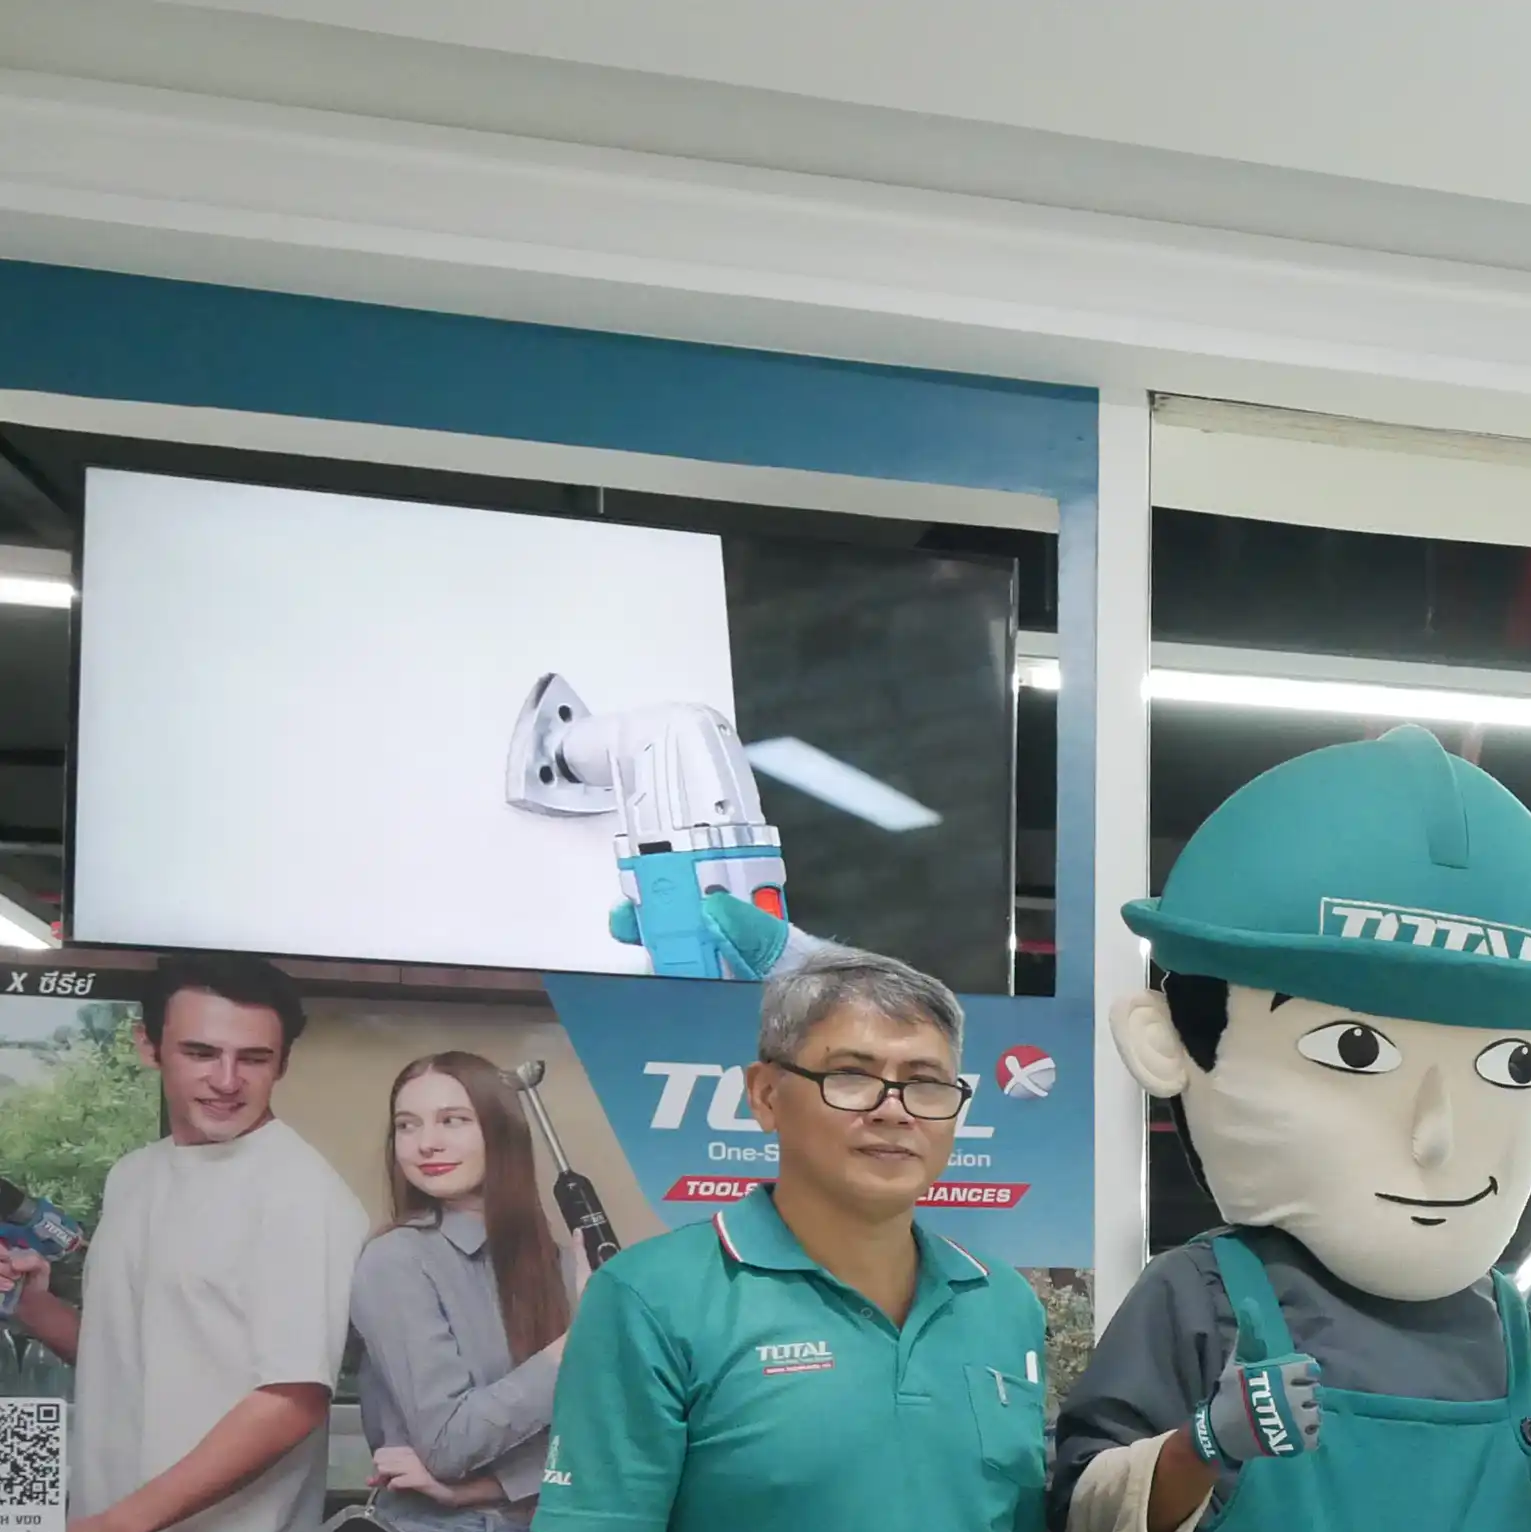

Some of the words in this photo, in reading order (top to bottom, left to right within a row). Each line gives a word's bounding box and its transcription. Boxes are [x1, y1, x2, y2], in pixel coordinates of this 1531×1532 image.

[643, 1061, 995, 1138] TOL
[755, 1341, 832, 1361] TOTAL
[1249, 1371, 1294, 1455] TOTAL
